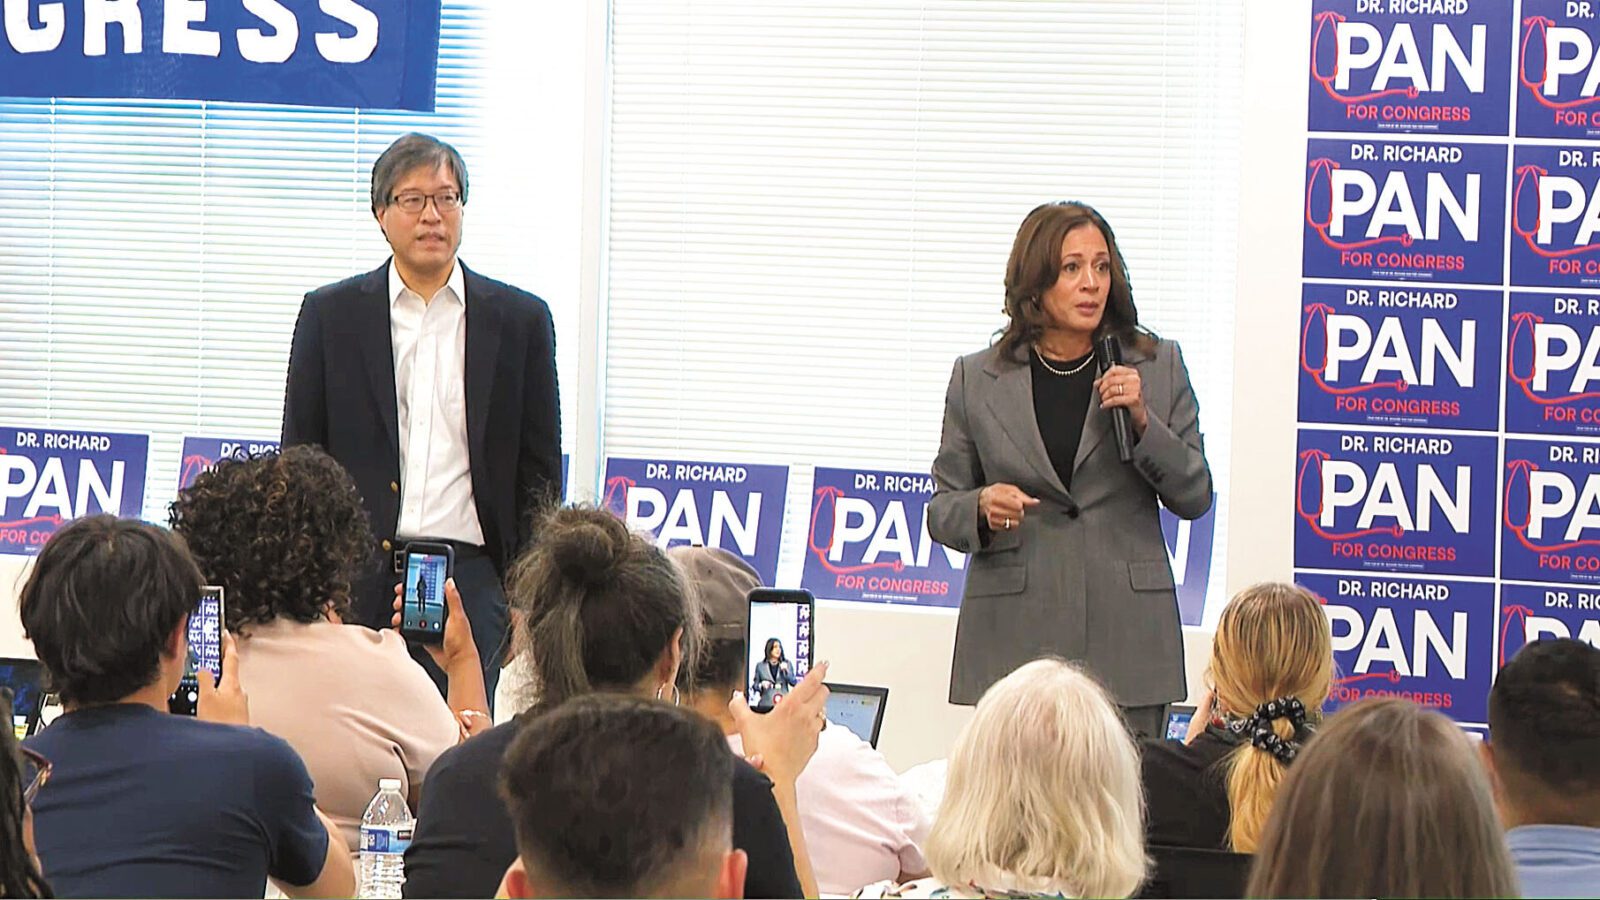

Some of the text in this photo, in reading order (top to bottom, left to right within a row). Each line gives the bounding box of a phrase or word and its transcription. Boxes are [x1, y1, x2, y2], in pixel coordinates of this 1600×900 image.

[1356, 0, 1469, 15] DR. RICHARD
[1566, 1, 1595, 19] DR.
[4, 0, 380, 64] GRESS
[1334, 21, 1487, 94] PAN
[1346, 104, 1471, 122] FOR CONGRESS
[1554, 110, 1587, 126] FOR
[1351, 143, 1463, 164] DR. RICHARD
[1559, 150, 1588, 167] DR.
[1329, 168, 1481, 242] PAN
[1341, 251, 1465, 271] FOR CONGRESS
[1549, 259, 1581, 275] FOR
[1346, 289, 1458, 309] DR. RICHARD
[1554, 298, 1583, 315] DR.
[1324, 314, 1476, 388] PAN
[1336, 396, 1461, 416] FOR CONGRESS
[1544, 406, 1576, 421] FOR
[16, 431, 111, 451] DR. RICHARD
[1341, 435, 1453, 456] DR. RICHARD
[1549, 445, 1578, 463] DR.
[646, 463, 747, 483] DR. RICHARD
[854, 473, 880, 491] DR.
[0, 454, 125, 520] PAN
[1320, 460, 1471, 534] PAN
[626, 486, 762, 557] PAN
[0, 528, 27, 544] FOR
[1332, 542, 1457, 561] FOR CONGRESS
[1539, 554, 1571, 569] FOR
[835, 575, 950, 595] FOR CONGRESS
[1338, 579, 1450, 601] DR. RICHARD
[1545, 591, 1573, 609] DR.
[1327, 604, 1468, 680] PAN
[1329, 686, 1360, 701] FOR
